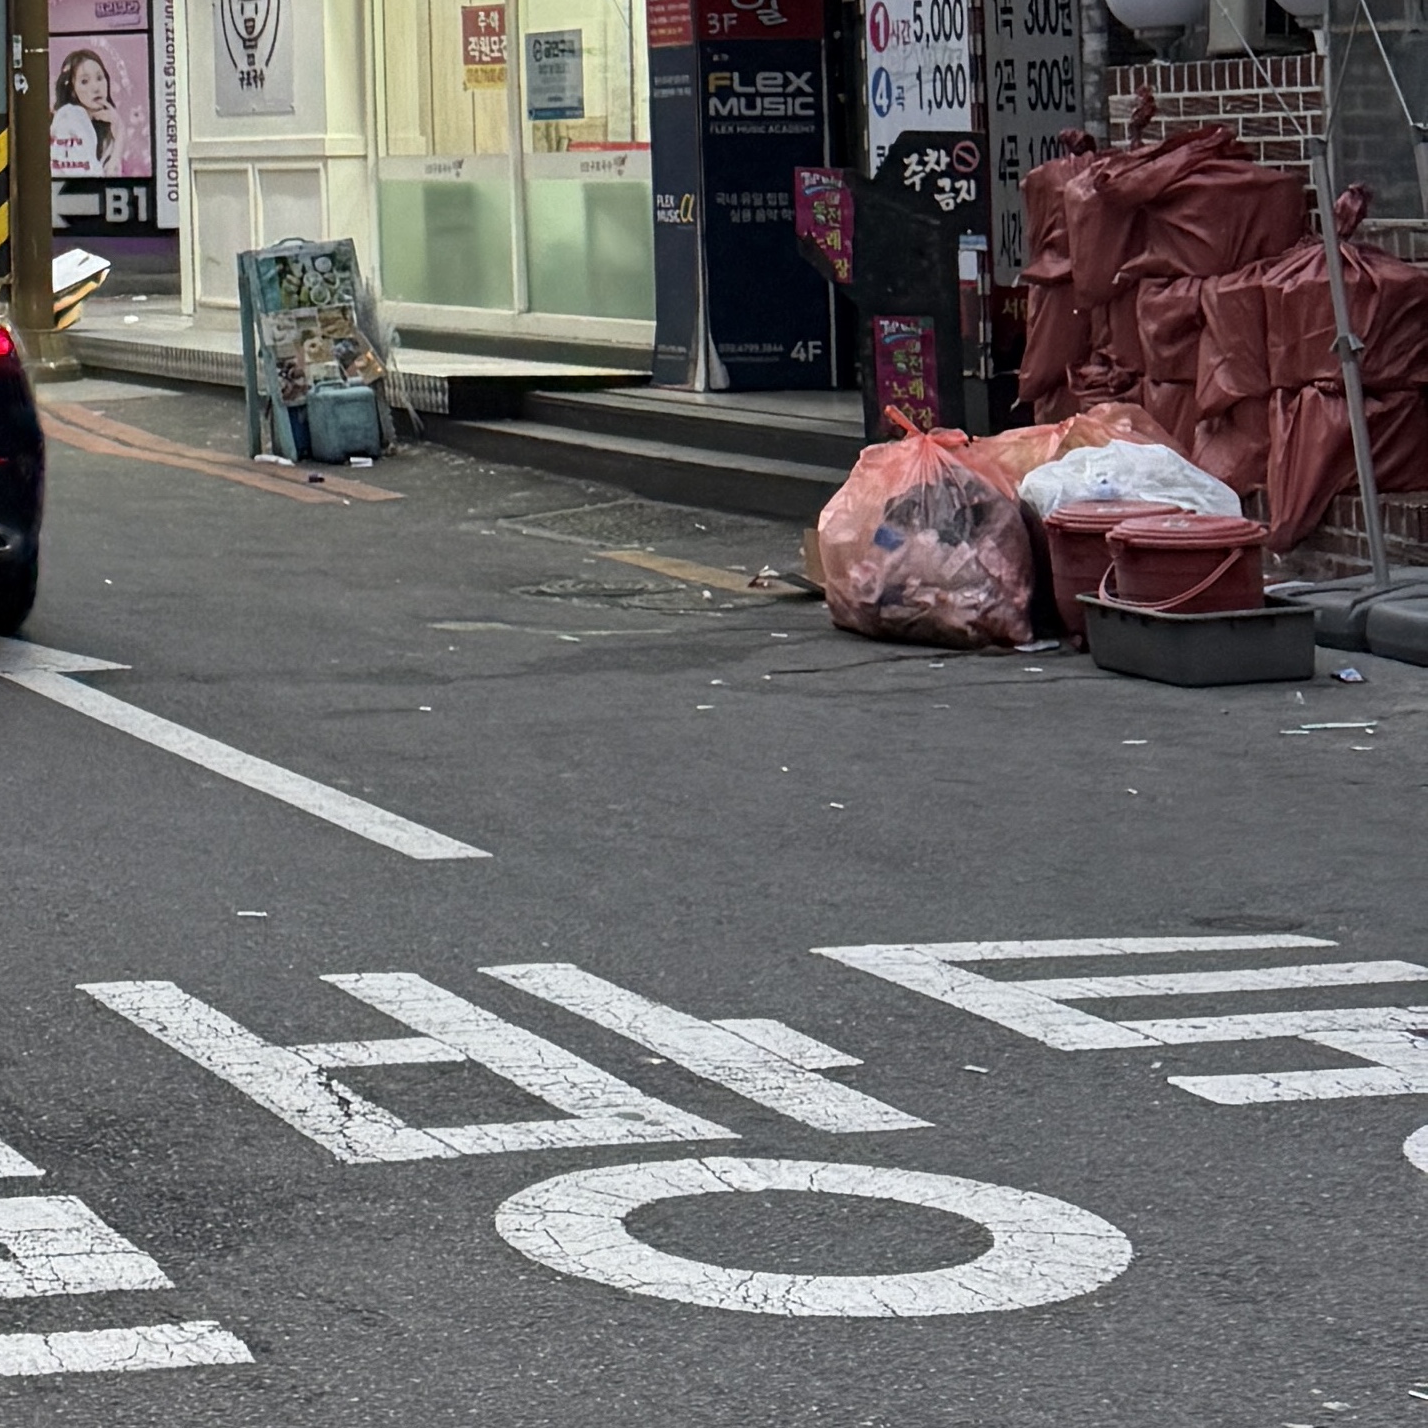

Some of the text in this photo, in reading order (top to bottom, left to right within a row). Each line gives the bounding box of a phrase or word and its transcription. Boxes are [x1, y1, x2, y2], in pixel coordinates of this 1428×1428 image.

[707, 12, 738, 34] 3F
[915, 63, 967, 116] 1,000
[995, 55, 1077, 115] 2곡 500원
[163, 80, 179, 146] STICKER
[708, 96, 816, 117] MUSIC
[165, 147, 180, 203] PHOTO
[902, 147, 952, 193] 주차
[998, 135, 1020, 189] 4곡
[104, 185, 148, 224] B1
[656, 194, 675, 208] FLEX
[933, 179, 977, 212] 금지
[790, 340, 823, 362] 4F
[891, 379, 925, 402] 노래
